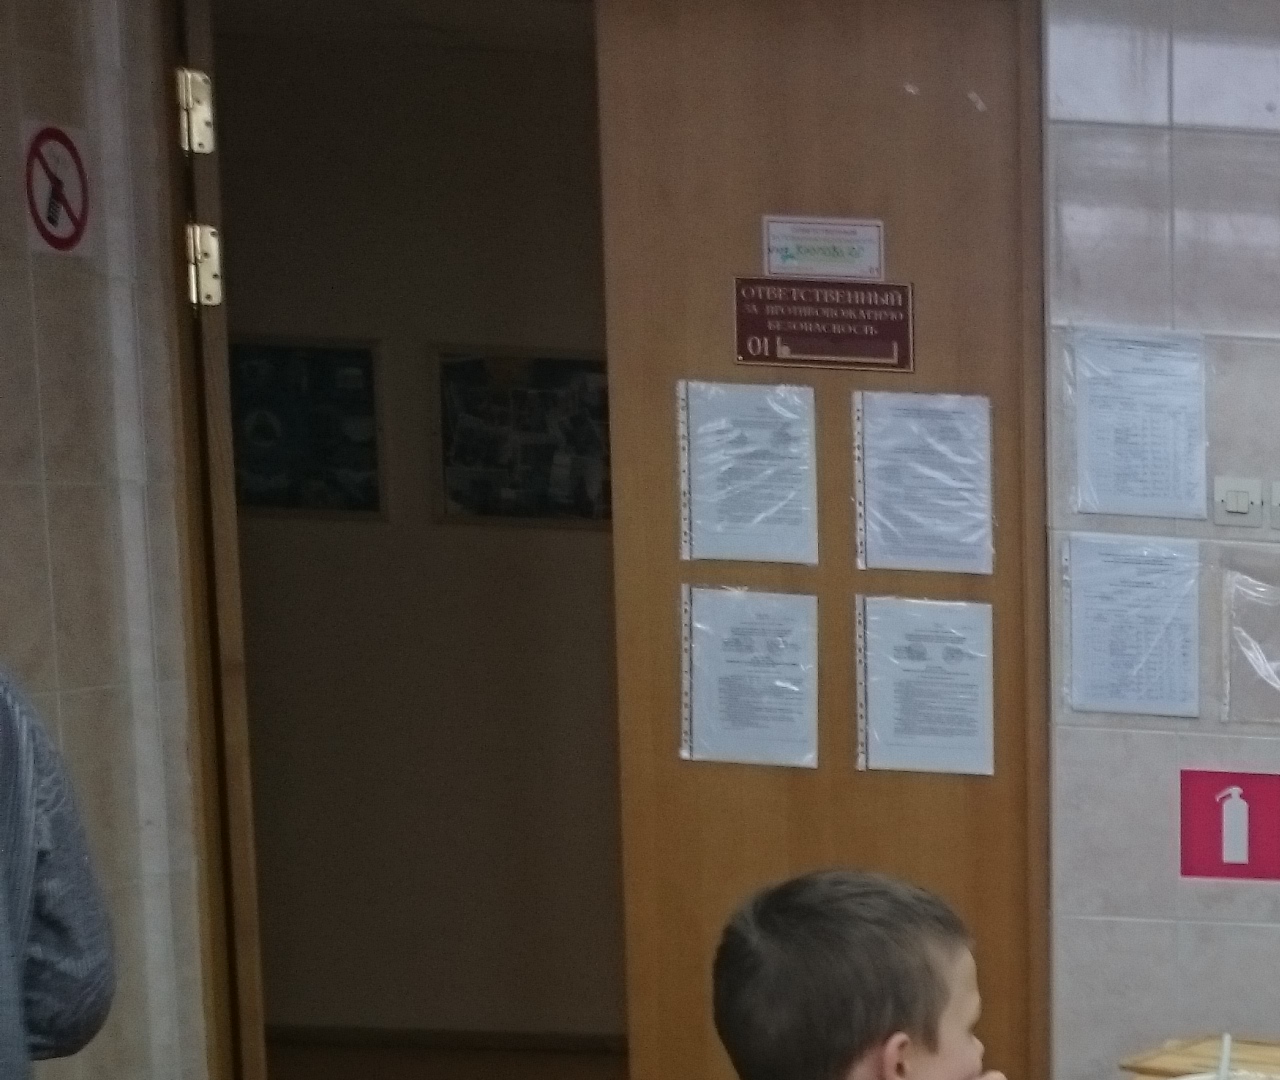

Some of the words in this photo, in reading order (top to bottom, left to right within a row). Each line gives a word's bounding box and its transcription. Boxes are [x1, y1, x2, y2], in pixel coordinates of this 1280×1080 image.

[740, 286, 903, 307] ОТВЕТСТВЕННЫЙ
[767, 319, 878, 336] БЕЗОПАСНОСТЬ
[747, 335, 770, 357] 01
